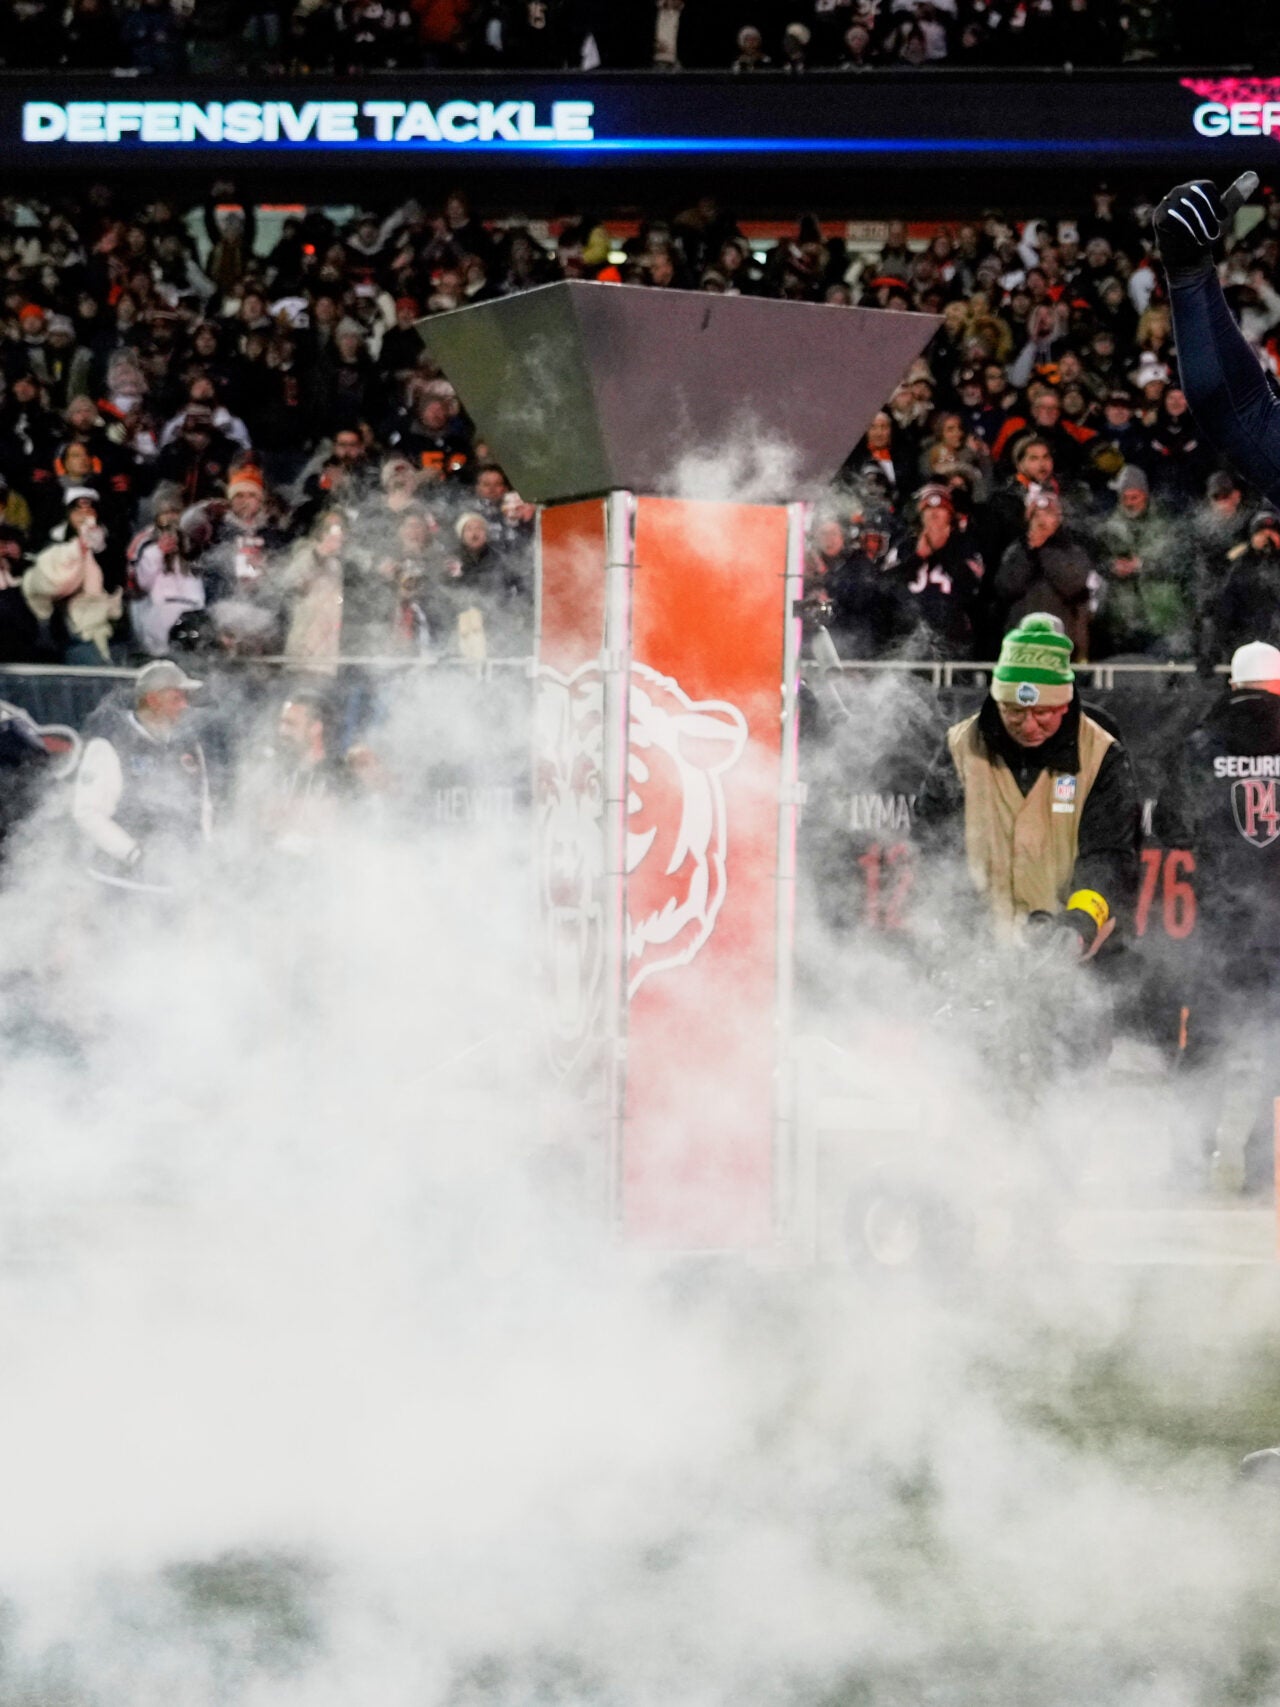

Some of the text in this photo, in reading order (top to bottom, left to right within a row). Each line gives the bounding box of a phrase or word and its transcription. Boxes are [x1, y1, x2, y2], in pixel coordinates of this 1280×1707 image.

[23, 102, 594, 142] DEFENSIVE TACKLE
[851, 794, 916, 830] LYMA
[1242, 780, 1280, 837] P4
[1136, 848, 1196, 940] 76
